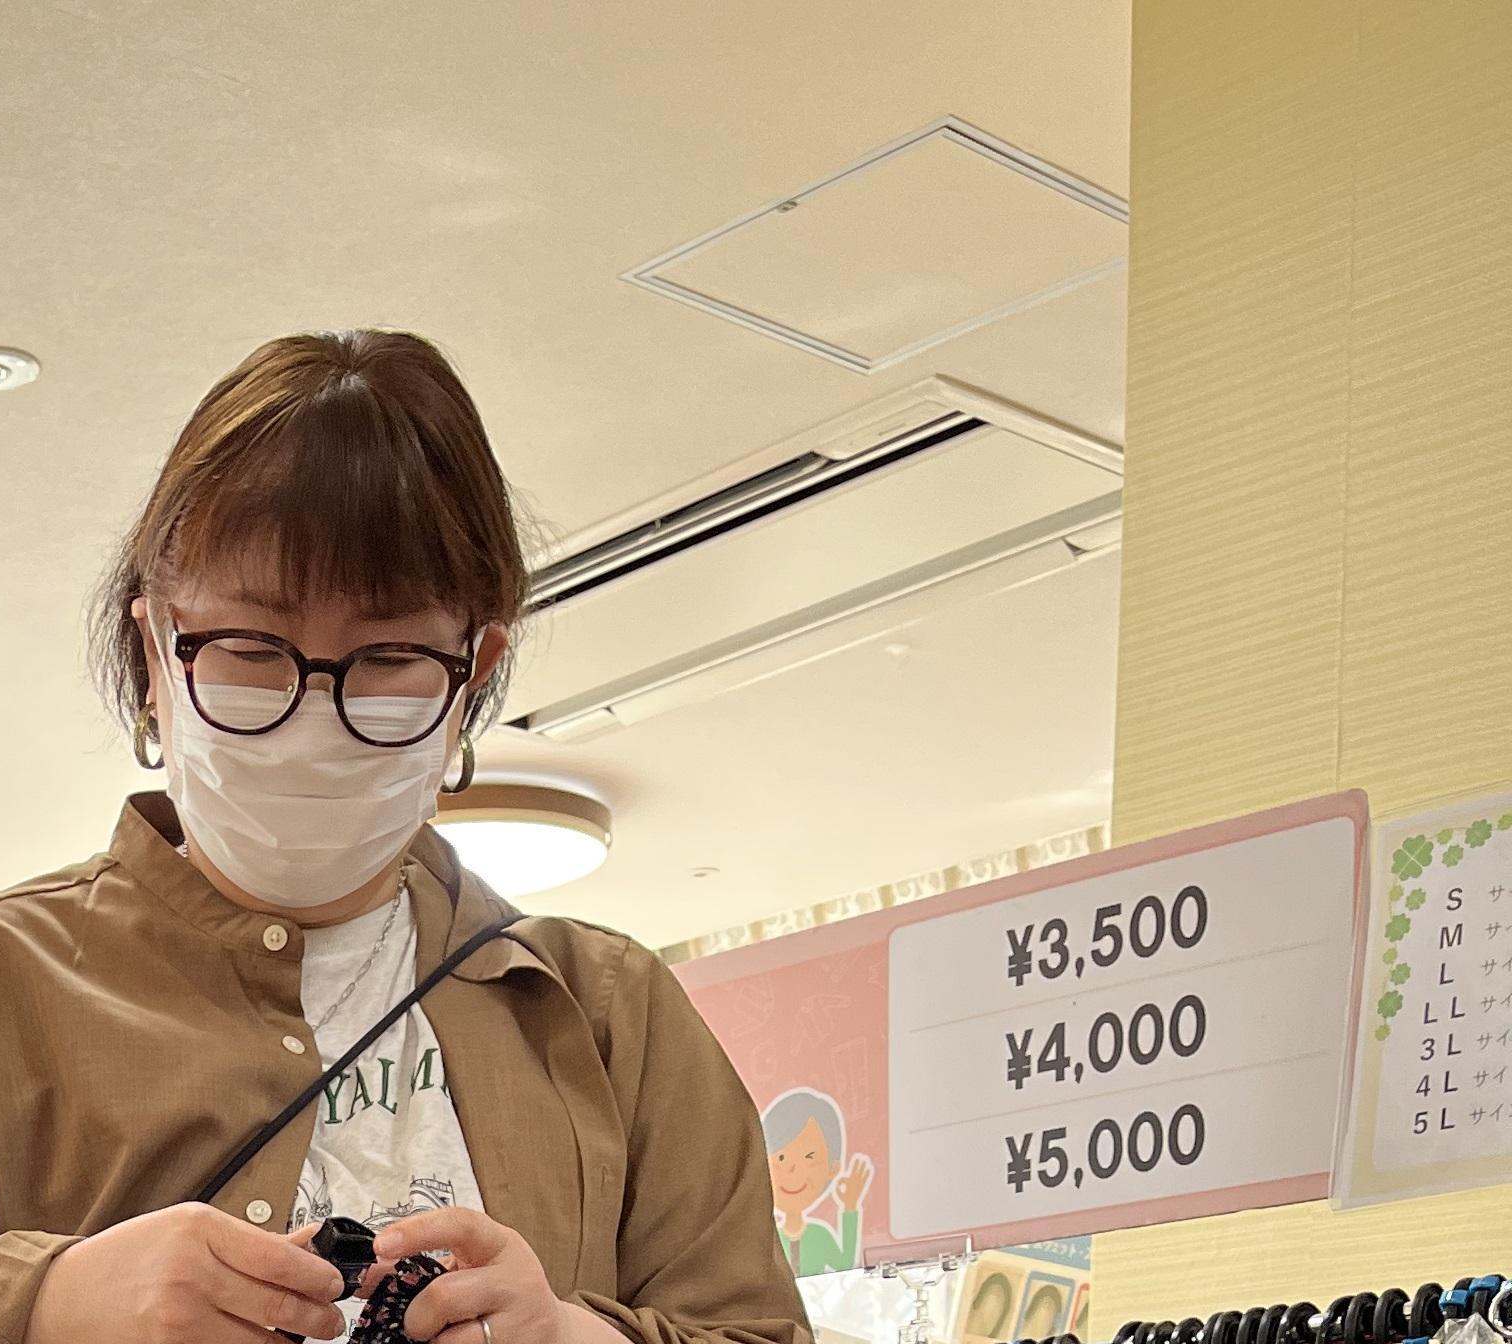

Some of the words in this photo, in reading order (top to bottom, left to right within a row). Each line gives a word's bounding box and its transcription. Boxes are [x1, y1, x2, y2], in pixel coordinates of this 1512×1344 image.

[1447, 887, 1463, 911] S
[1006, 886, 1208, 986] ¥3,500
[1439, 923, 1463, 950] M
[1440, 963, 1454, 985] L
[1006, 995, 1207, 1089] ¥4,000
[1476, 1029, 1512, 1050] サイ
[1470, 1104, 1512, 1126] サイ
[1006, 1104, 1205, 1193] ¥5,000
